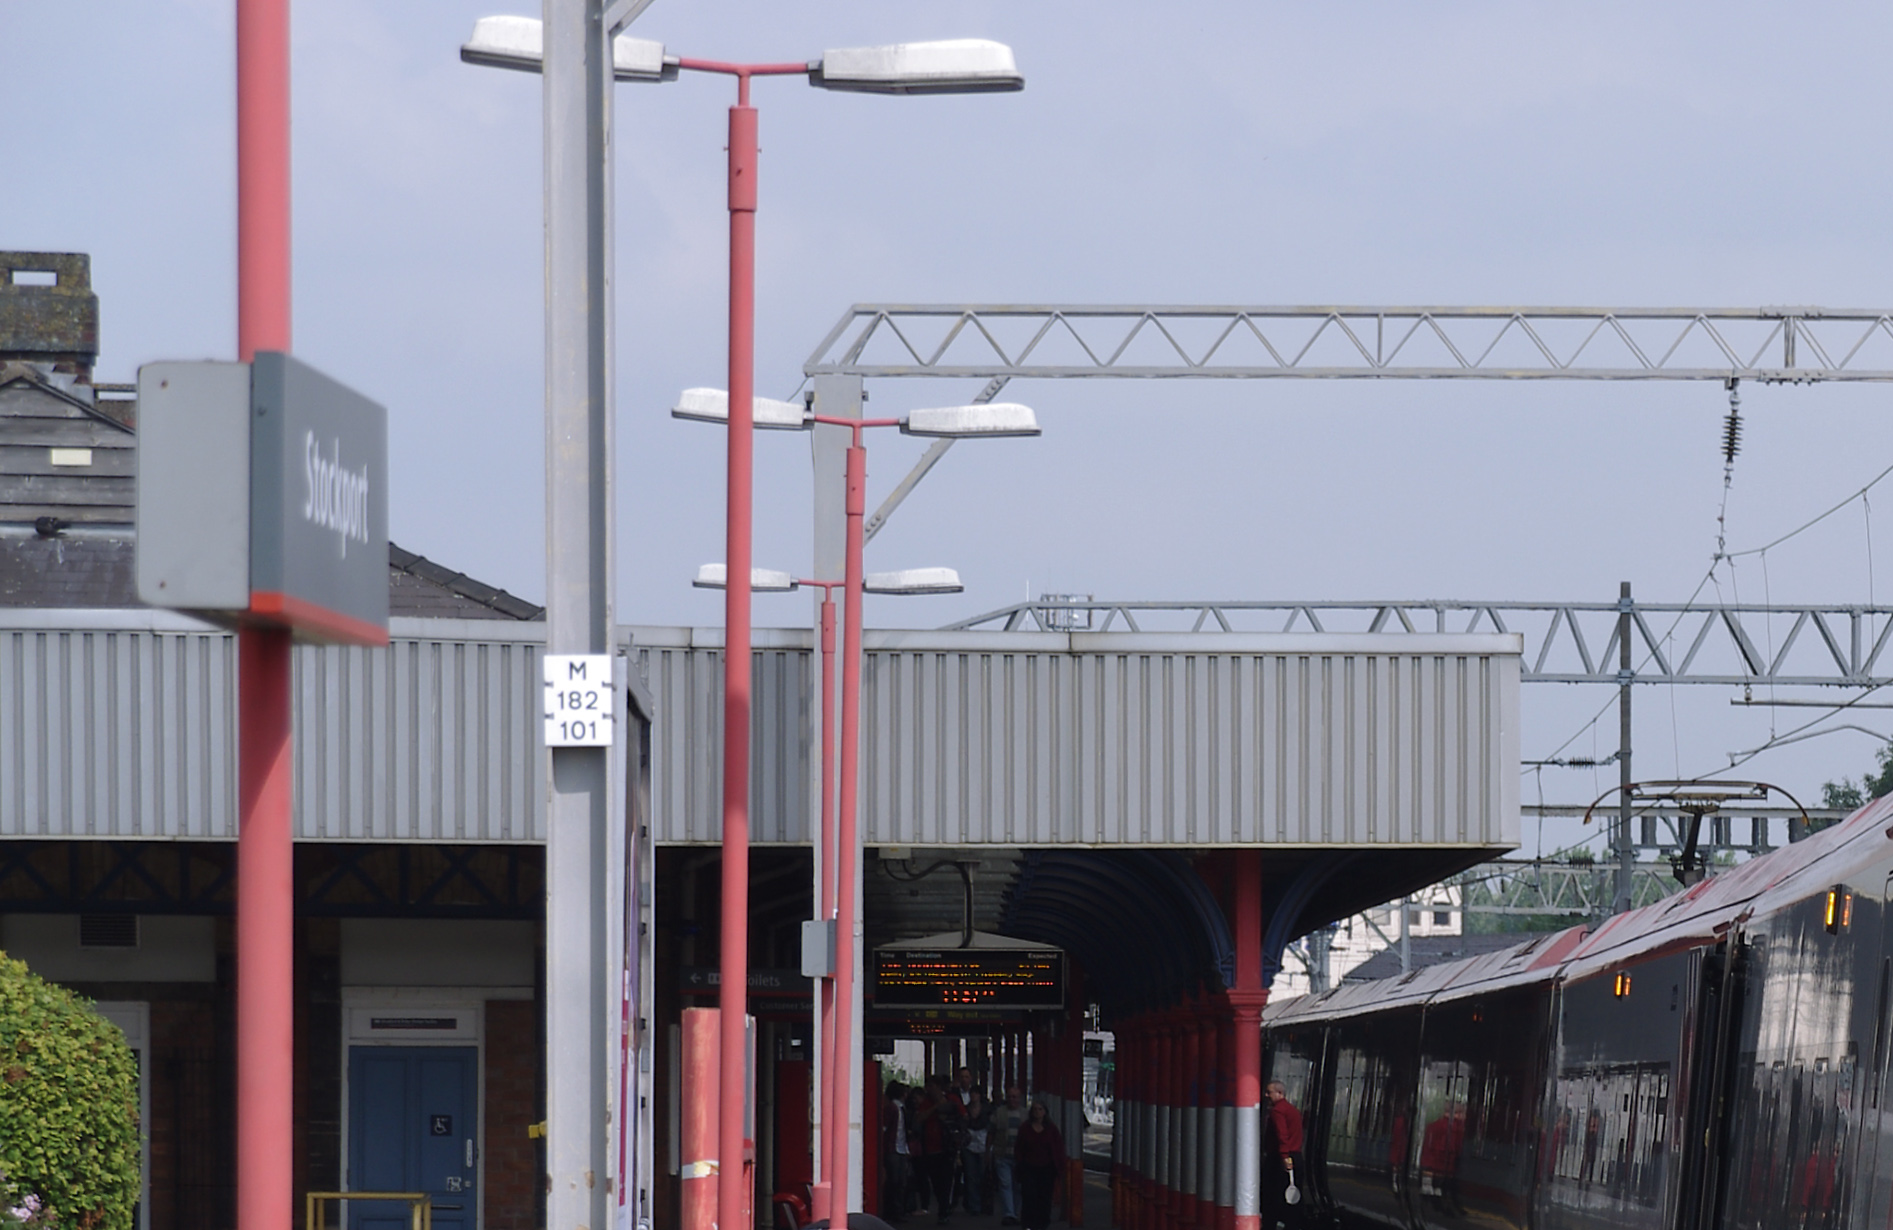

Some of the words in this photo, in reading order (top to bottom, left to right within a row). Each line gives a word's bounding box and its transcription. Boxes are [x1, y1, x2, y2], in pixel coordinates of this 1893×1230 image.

[304, 430, 369, 558] Stockport
[568, 662, 588, 681] M
[556, 690, 599, 711] 182
[559, 720, 598, 741] 101
[748, 974, 781, 987] oilets
